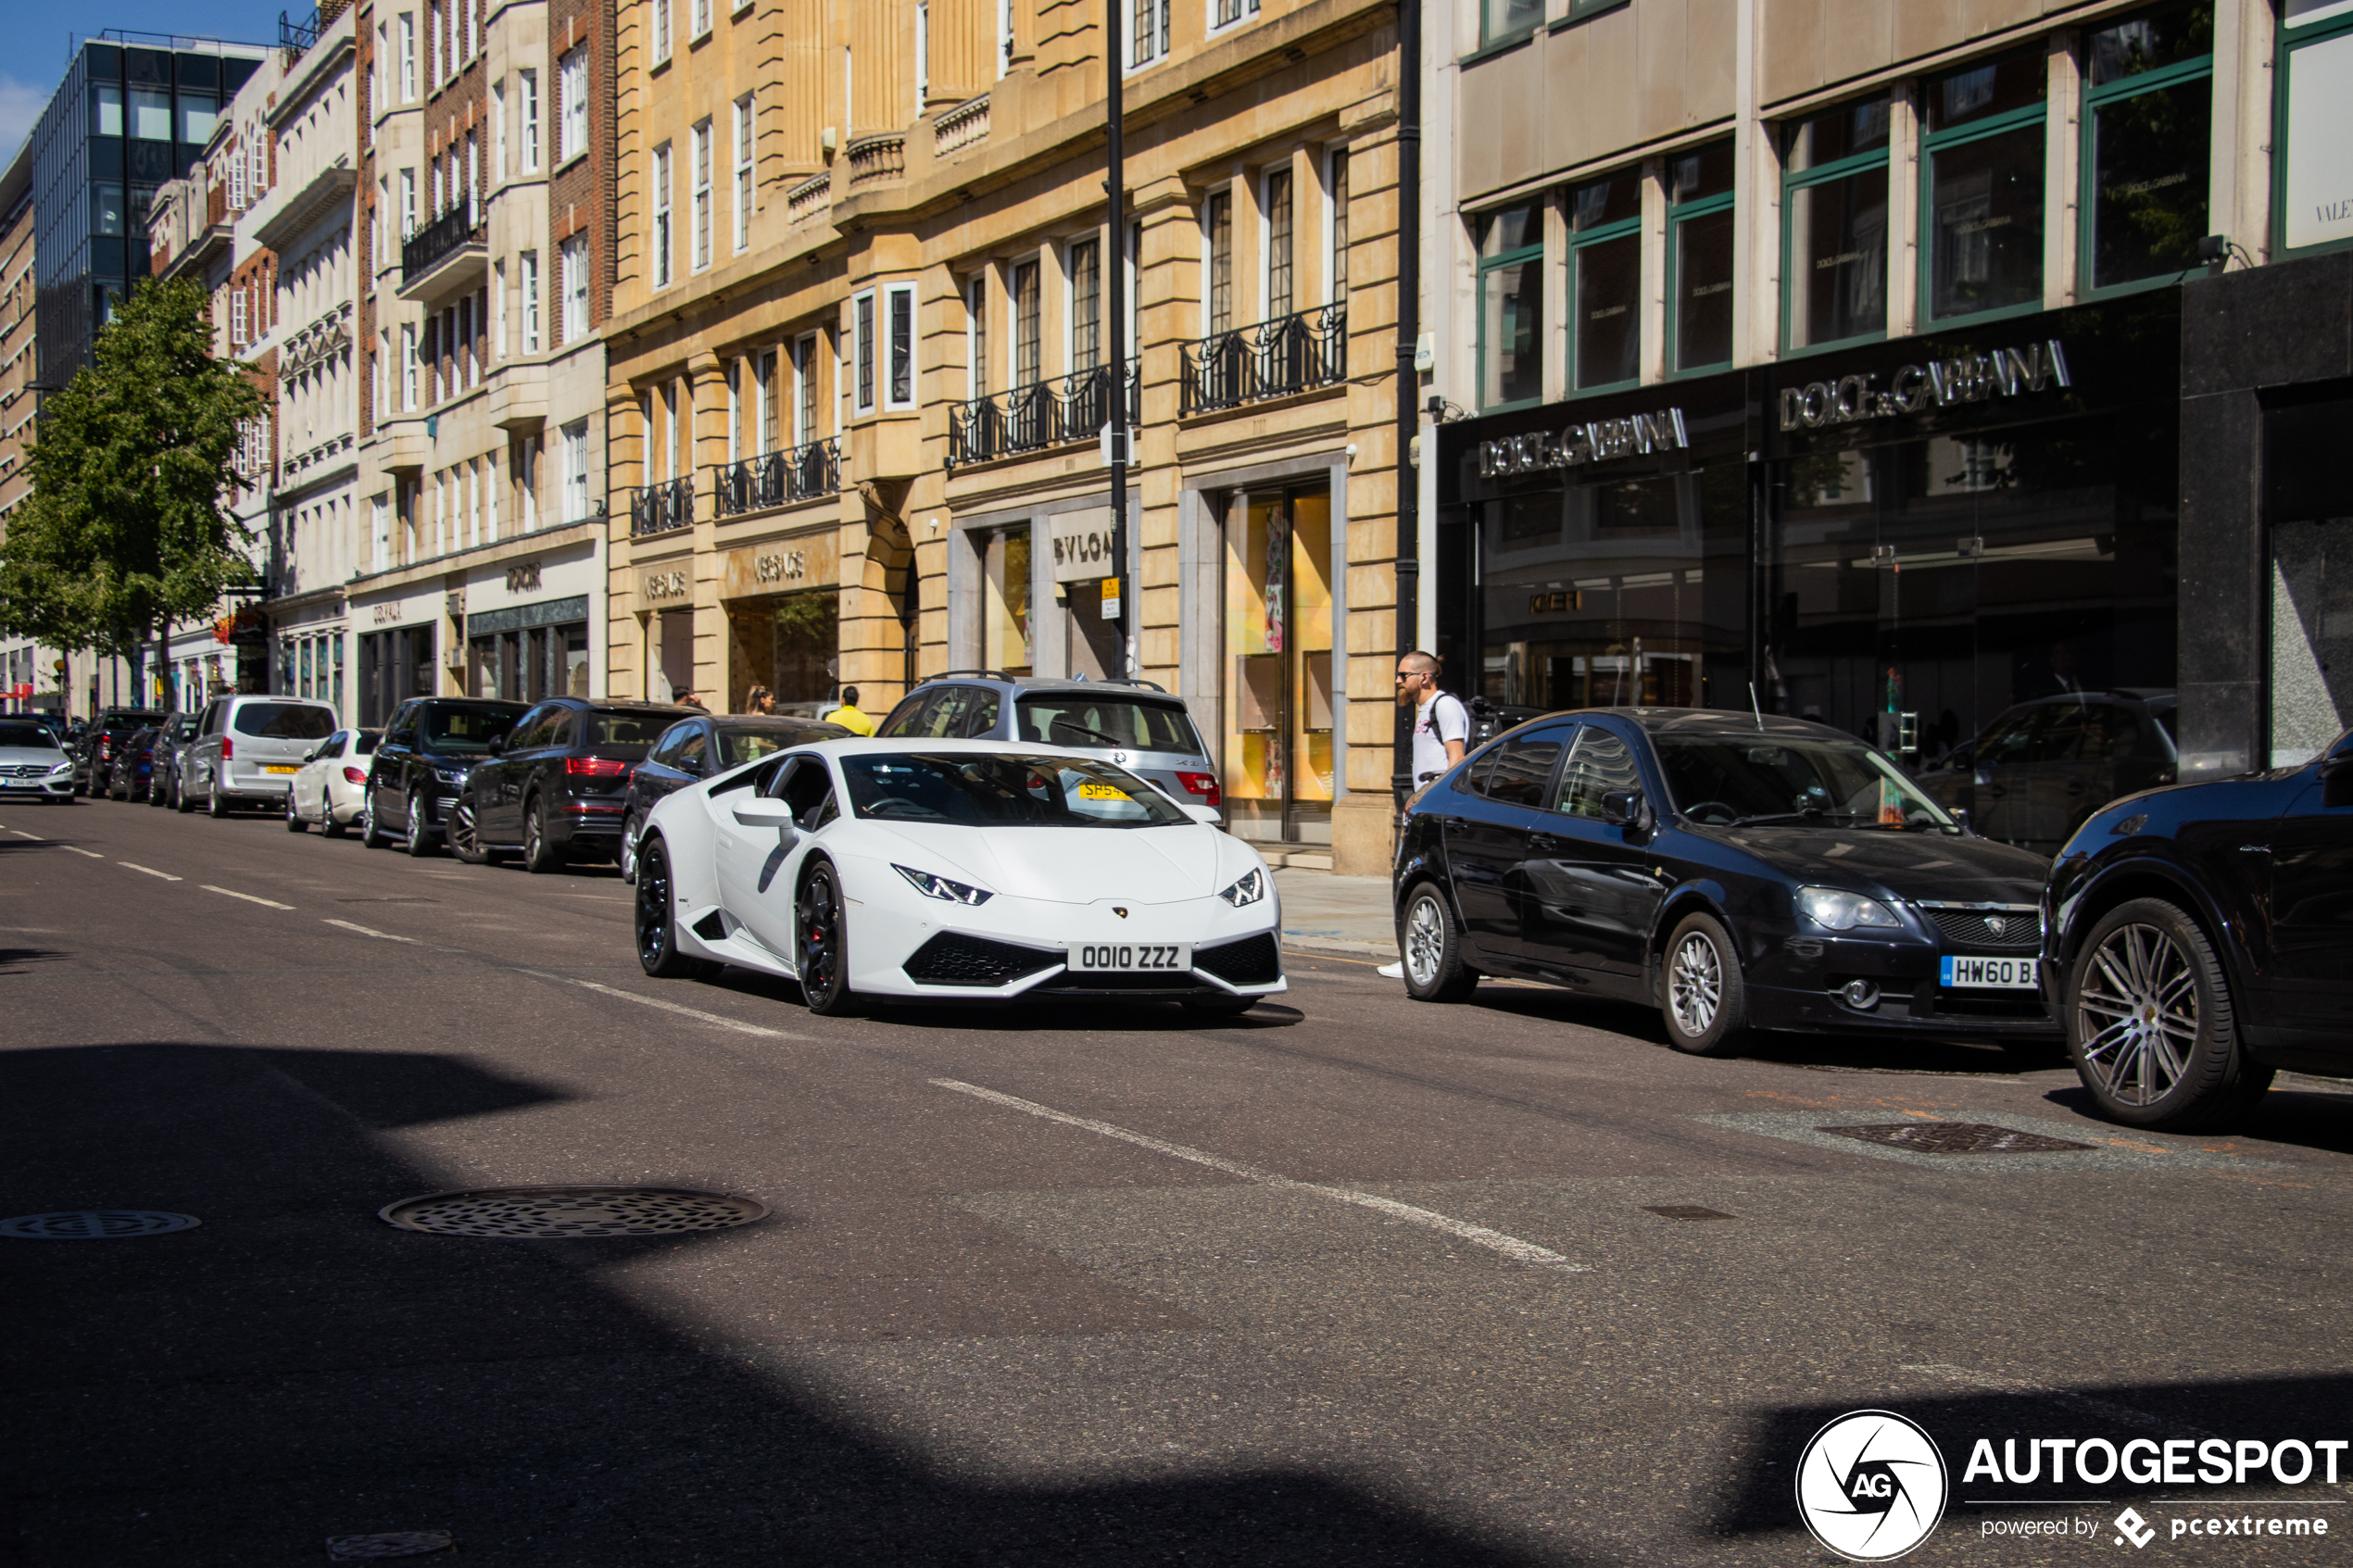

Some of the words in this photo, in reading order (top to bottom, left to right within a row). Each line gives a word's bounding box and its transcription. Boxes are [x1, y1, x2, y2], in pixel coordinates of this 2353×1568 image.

[2316, 198, 2353, 223] VALE
[1053, 531, 1113, 559] BVLGA
[1139, 947, 1179, 968] ZZZ
[1957, 960, 2013, 983] HW60
